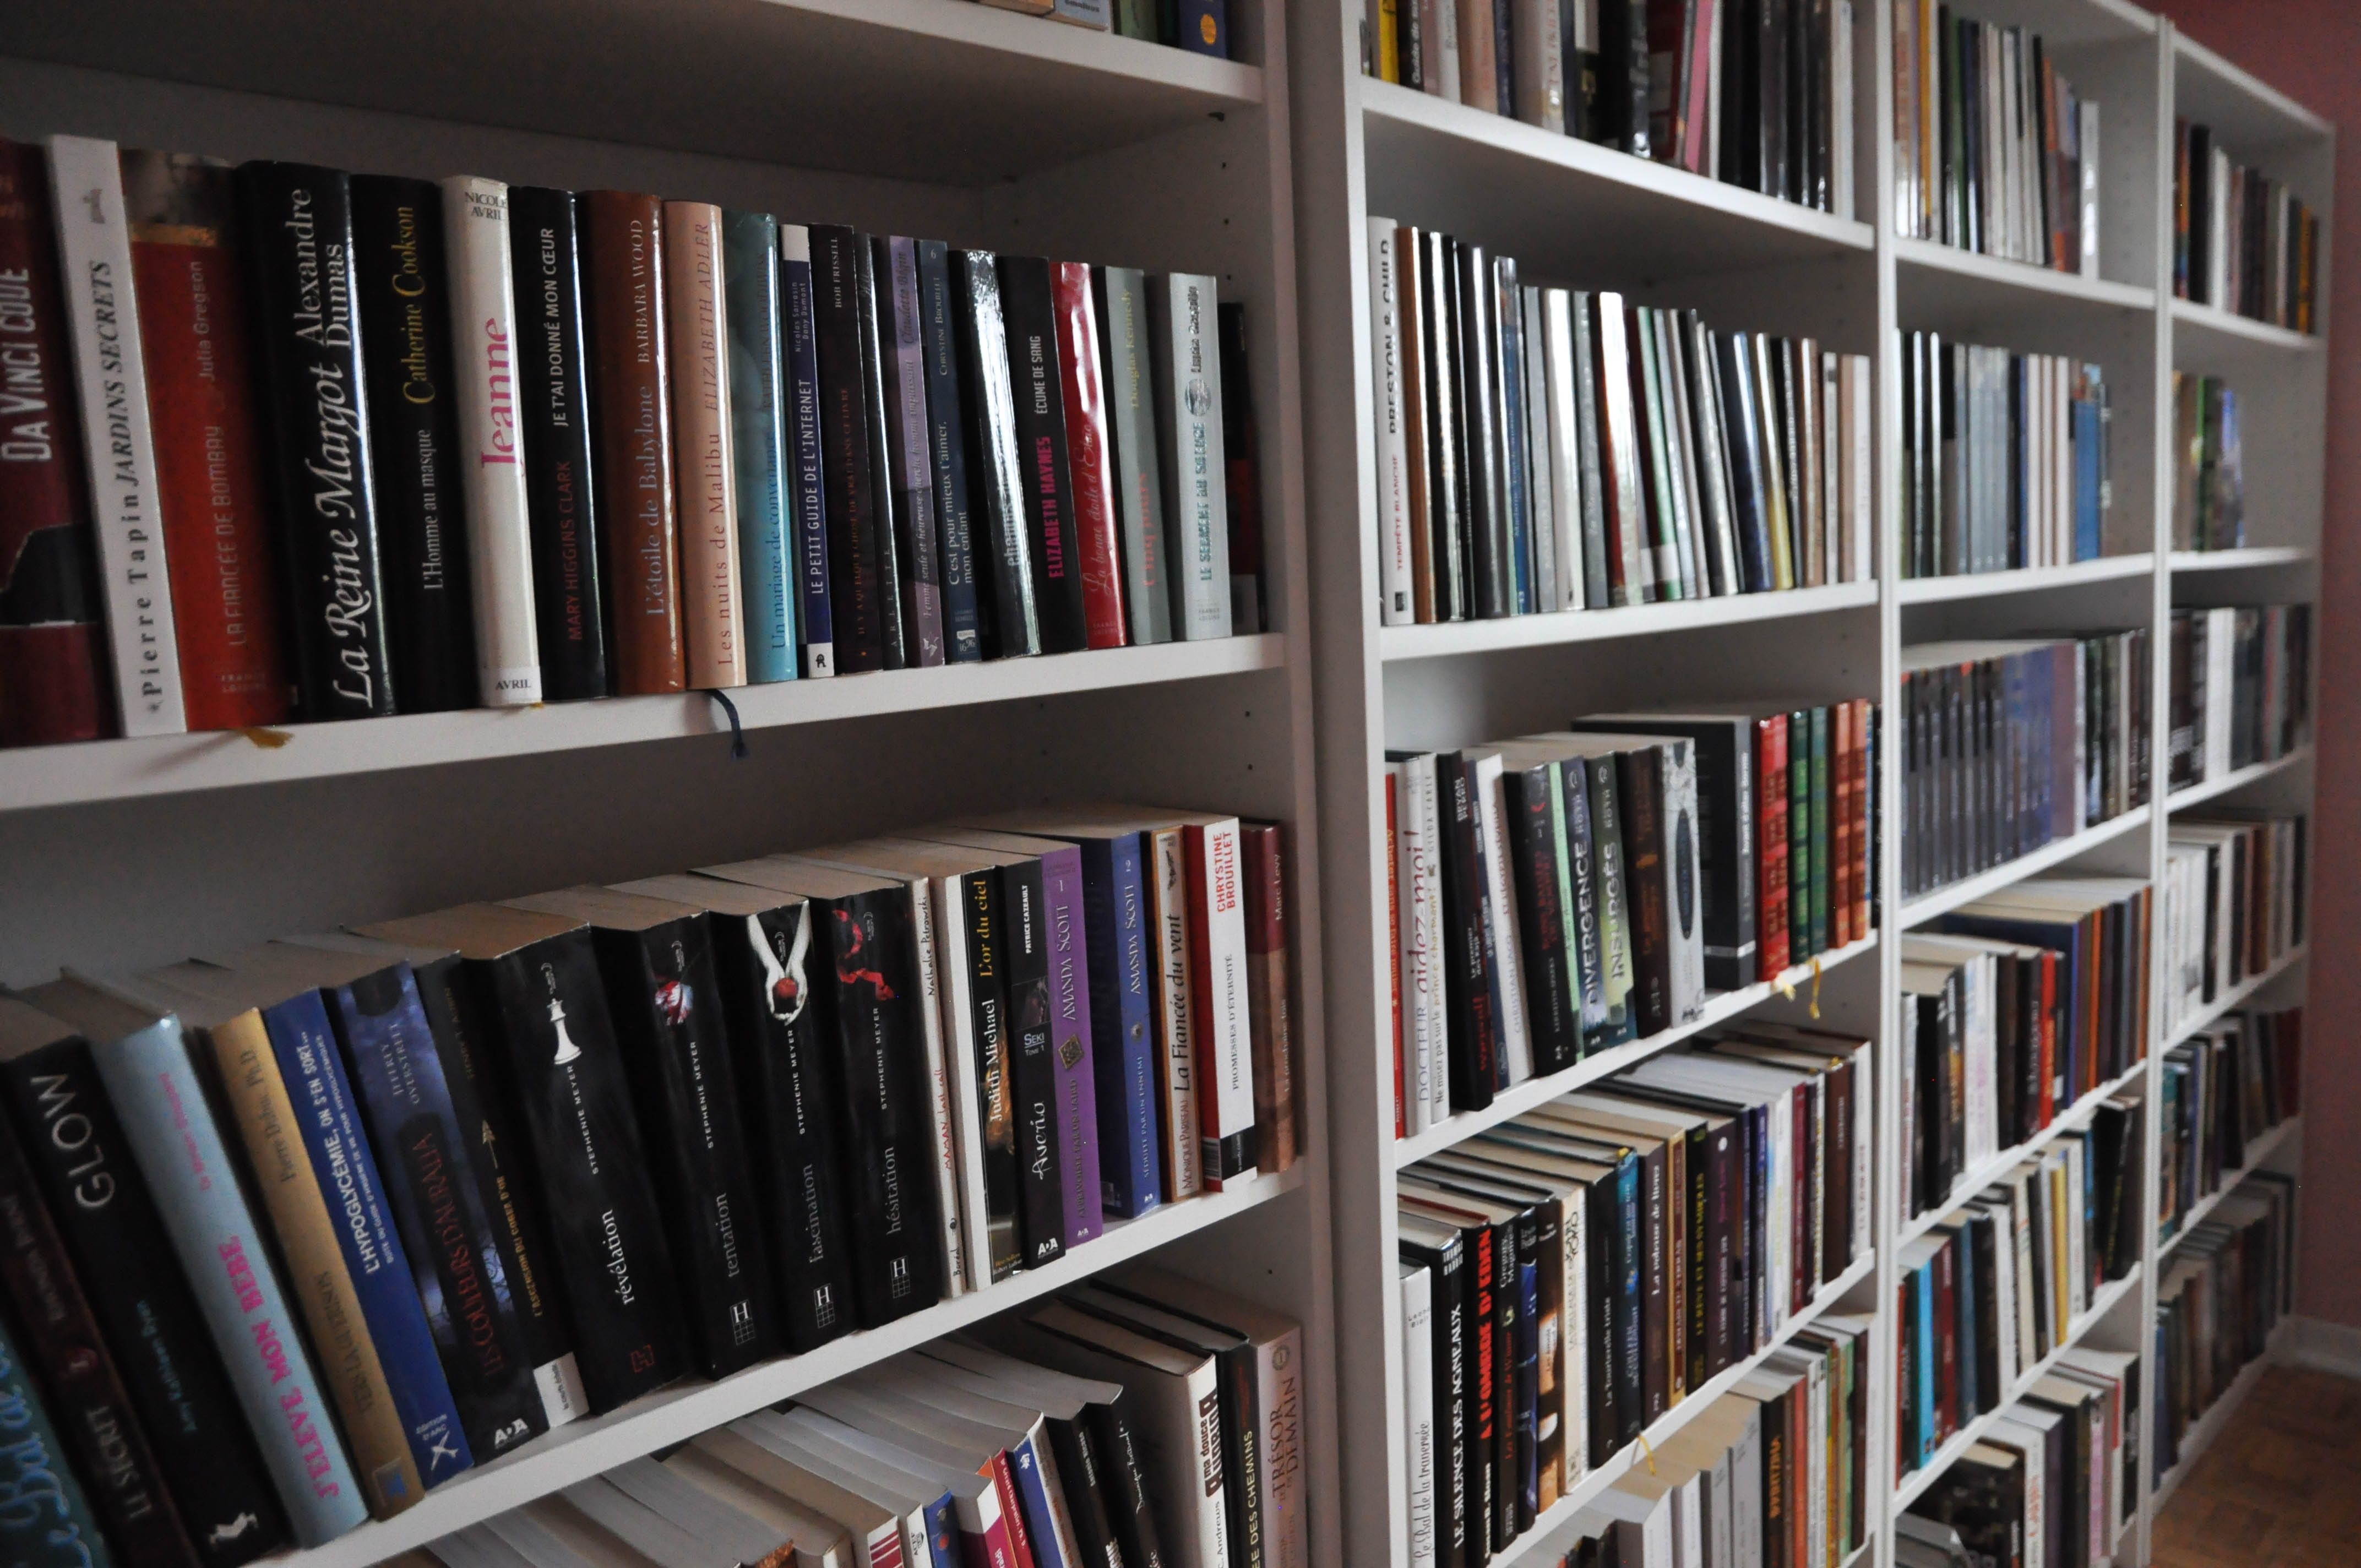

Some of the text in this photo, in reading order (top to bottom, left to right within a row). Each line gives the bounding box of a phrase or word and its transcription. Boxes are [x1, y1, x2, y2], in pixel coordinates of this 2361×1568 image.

[285, 188, 325, 347] Alexandre
[325, 243, 351, 350] Dumas
[391, 206, 435, 404] Catherine Cookson
[630, 220, 650, 363] BARBARA WOOD
[695, 224, 717, 410] ELIZABETH ADLER
[799, 282, 809, 340] Dany Dumont
[830, 237, 842, 308] BOB FRISSELL
[0, 268, 48, 415] VINCI CODE
[189, 262, 215, 380] Julia Gregson
[540, 228, 569, 427] JE T'AI DONNÉ MON CŒUR
[793, 320, 802, 352] Nicolas
[90, 259, 138, 486] JARDINS SECRETS
[1029, 335, 1048, 414] ÉCUME DE SANG
[205, 426, 247, 646] LA FIANCÉE DE BOMBAY
[305, 362, 373, 708] La Reine Margot
[416, 429, 444, 590] L'Homme au masque
[634, 386, 665, 615] L'étoile de Babylone
[798, 379, 824, 594] LE PETIT GUIDE DE L'INTERNET
[939, 475, 954, 512] mieux
[945, 518, 960, 548] pour
[1036, 437, 1064, 579] ELIZABETH HAYNES
[120, 494, 162, 697] Pierre Tapin
[556, 461, 583, 640] MARY HIGGINS CLARK
[705, 434, 733, 666] Les nuits de Malibu
[765, 532, 786, 649] Un mariage de
[918, 543, 927, 552] et
[946, 552, 960, 585] C'est
[958, 511, 973, 584] mon enfant
[496, 679, 531, 690] AVRIL
[1021, 884, 1031, 922] CAZEAULT
[1212, 833, 1226, 913] CHRYSTINE
[1222, 832, 1236, 910] BROUILLET
[1272, 854, 1282, 921] Marc Levy
[1602, 842, 1626, 980] INSURGÉS
[918, 896, 935, 996] Nathalie Petrowski
[973, 880, 994, 977] L'or du ciel
[1055, 904, 1076, 1020] AMANDA SCOTT
[1124, 884, 1141, 994] AMANDA SCOTT
[1574, 842, 1598, 1006] DIVERGENCE
[1024, 1033, 1045, 1045] SEKI
[1166, 914, 1190, 1091] La Fiancée du vent
[1433, 1039, 1444, 1057] pas
[308, 1079, 335, 1127] ON S'EN
[690, 1041, 714, 1150] STEPHENIE MEYER
[787, 1029, 806, 1135] STEPHENIE MEYER
[872, 1008, 888, 1111] STEPHENIE MEYER
[982, 998, 1003, 1121] Judith Michael
[1229, 1023, 1239, 1091] PROMESSES
[1433, 1059, 1444, 1088] misez
[1434, 1090, 1445, 1103] Ne
[29, 1074, 116, 1208] GLOW
[567, 1066, 599, 1175] STEPHENIE MEYER
[1180, 1142, 1195, 1190] MONIQUE
[712, 1193, 740, 1278] tentation
[801, 1164, 824, 1264] fascination
[882, 1147, 902, 1235] hésitation
[600, 1208, 635, 1305] révélation
[950, 1246, 961, 1276] Boréal
[252, 1320, 292, 1385] MON
[1199, 1418, 1211, 1478] ma douce
[1243, 1430, 1257, 1509] CHEMINS
[1267, 1406, 1286, 1498] TRÉSOR
[1282, 1376, 1299, 1476] DEMAIN
[1450, 1303, 1465, 1549] LE SILENCE DES AGNEAUX
[1214, 1501, 1224, 1556] Andrews
[1249, 1511, 1259, 1545] DES
[1415, 1497, 1431, 1512] de
